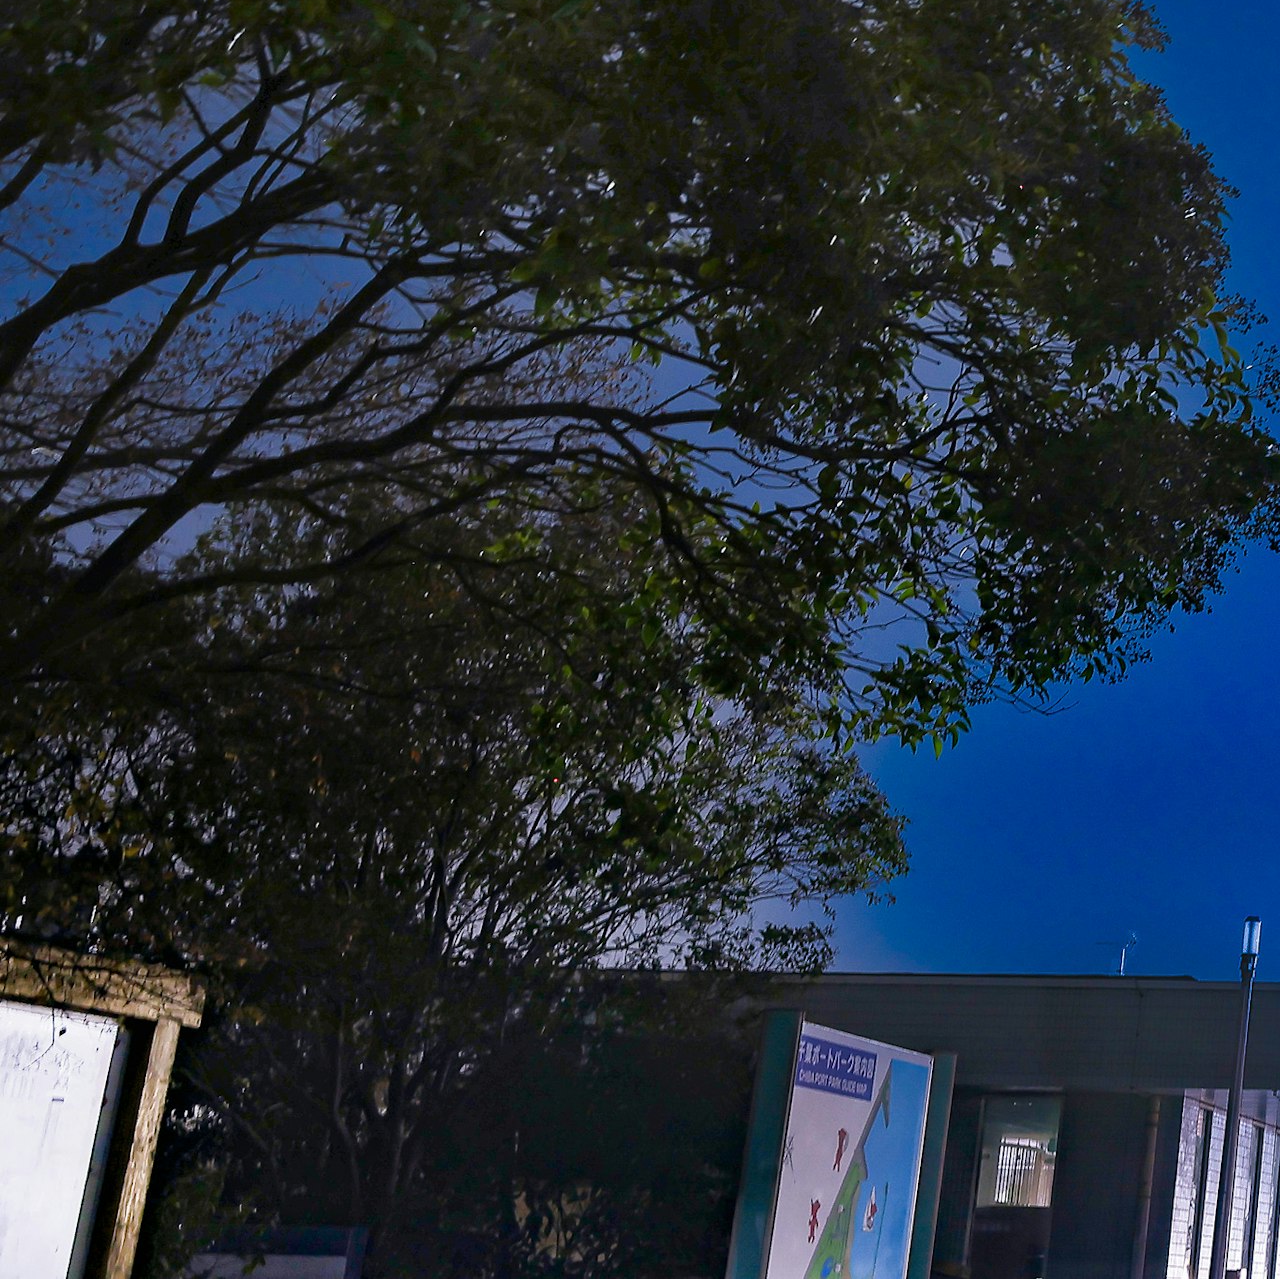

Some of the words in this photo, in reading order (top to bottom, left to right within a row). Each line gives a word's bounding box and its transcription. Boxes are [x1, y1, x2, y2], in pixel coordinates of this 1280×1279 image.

[799, 1069, 815, 1083] CHIBA
[815, 1072, 828, 1086] PORT
[828, 1075, 842, 1088] PARK
[842, 1079, 856, 1093] GUIDE
